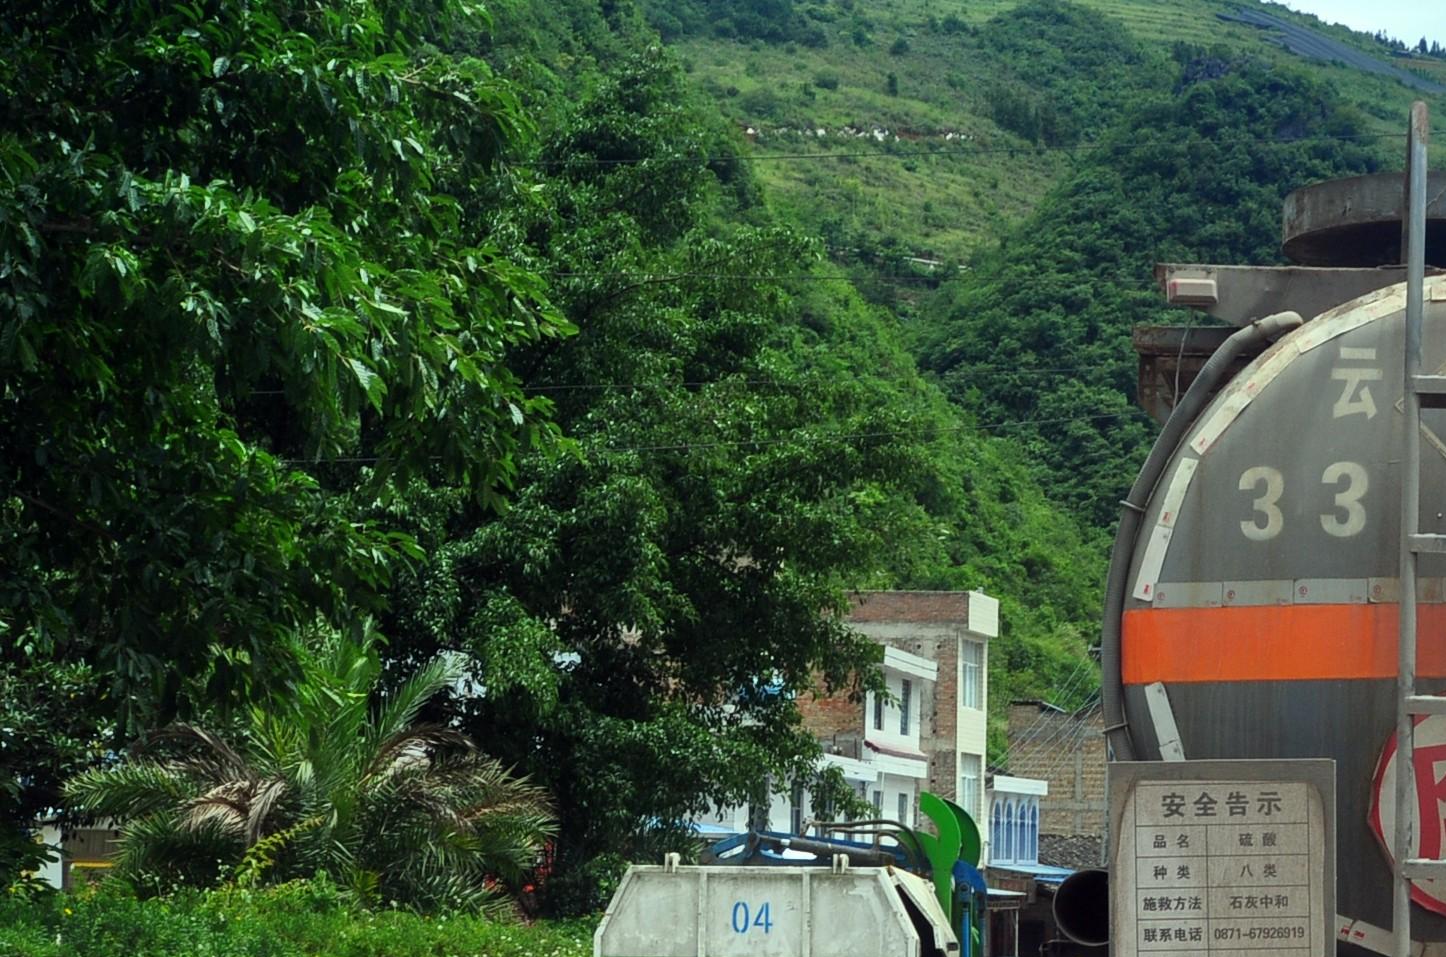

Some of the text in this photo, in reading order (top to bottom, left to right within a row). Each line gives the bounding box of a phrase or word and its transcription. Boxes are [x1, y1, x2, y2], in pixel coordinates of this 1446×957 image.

[1331, 347, 1384, 420] 云
[1161, 791, 1282, 818] 安全告示
[1152, 832, 1278, 849] 品名 硫酸
[1153, 863, 1278, 880] 种类 八类
[1142, 895, 1289, 911] 施救方法 石灰中和
[731, 901, 774, 935] 04
[1143, 926, 1305, 942] 联系电话 0871-67926919
